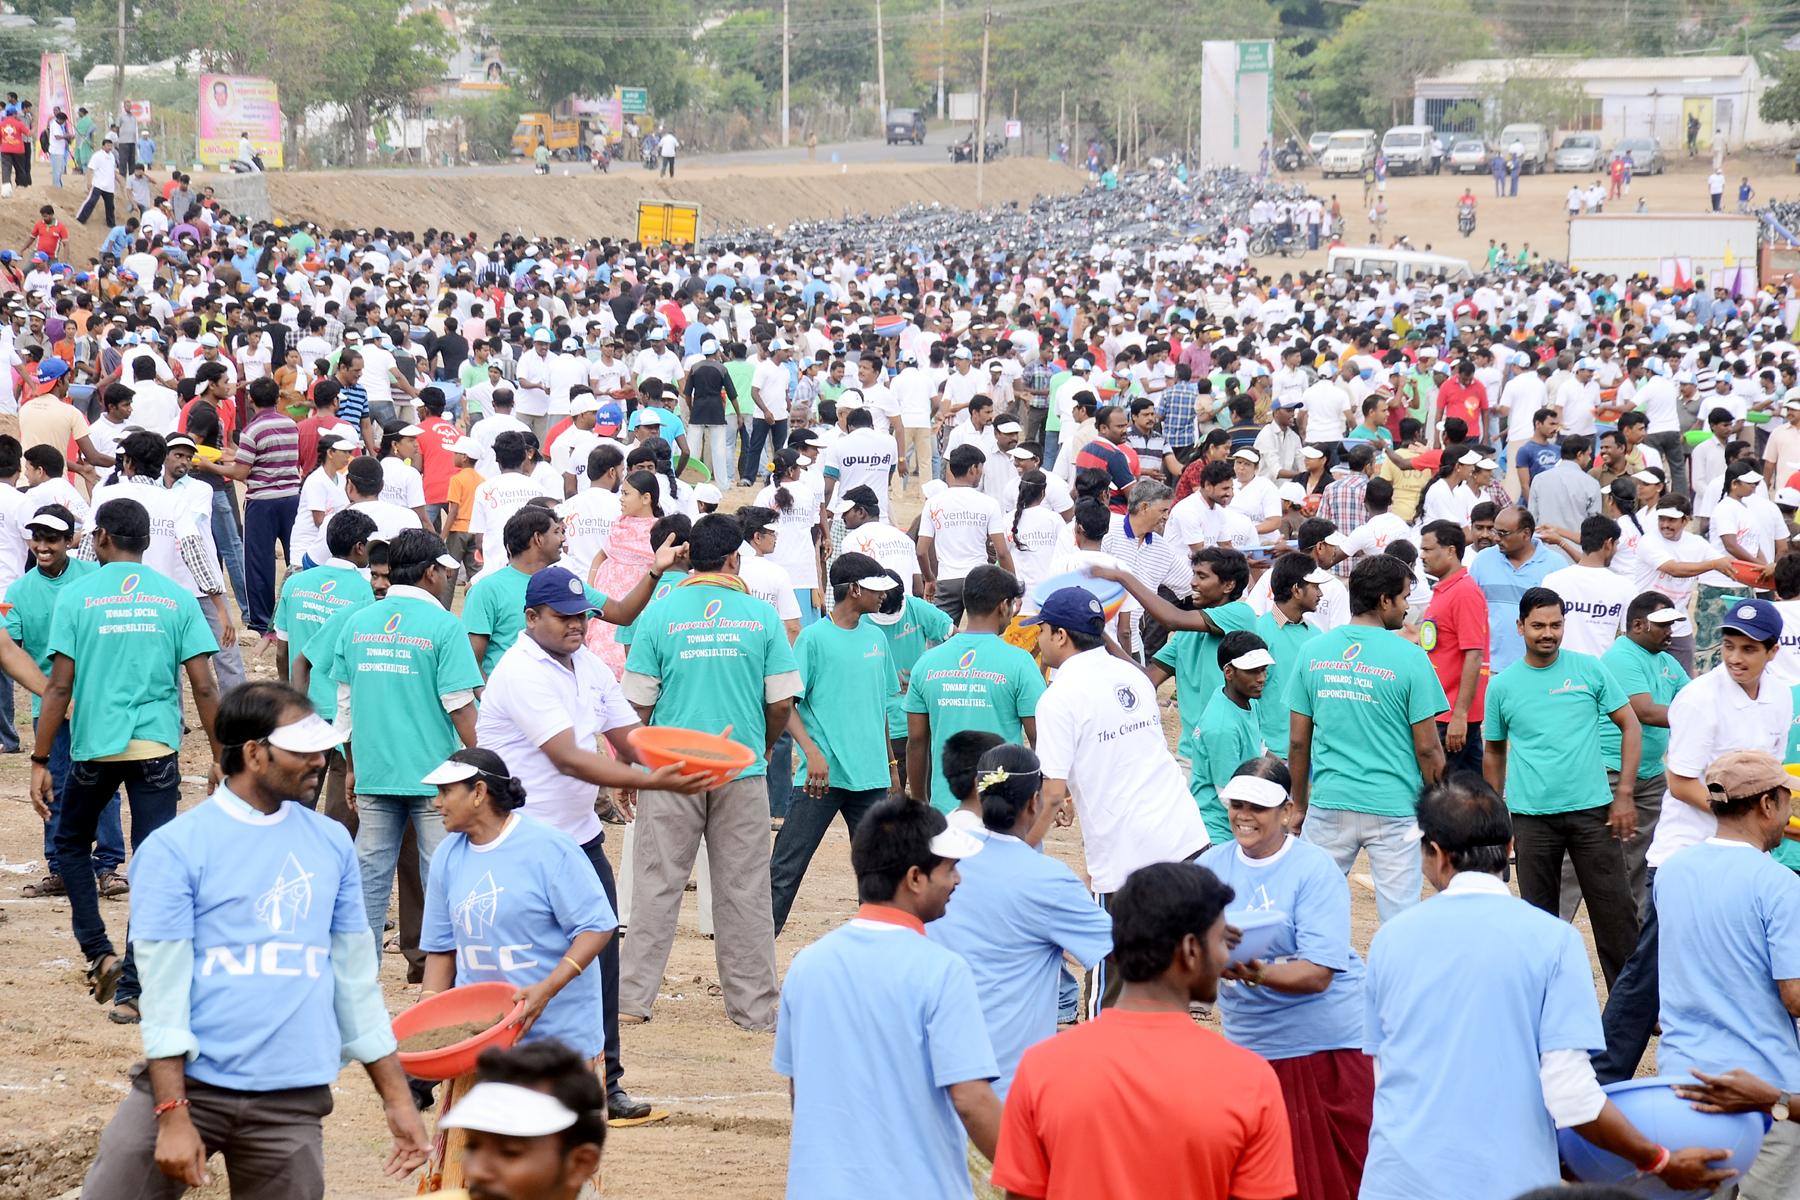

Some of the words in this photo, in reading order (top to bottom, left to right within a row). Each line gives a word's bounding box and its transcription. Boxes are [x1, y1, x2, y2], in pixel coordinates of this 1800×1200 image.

[842, 453, 891, 467] முயற்சி
[943, 511, 987, 521] venttura
[1019, 530, 1058, 540] enttura
[686, 634, 714, 645] TOWARD
[716, 633, 741, 643] SOCIAL
[1097, 729, 1117, 743] The
[456, 943, 538, 972] CC
